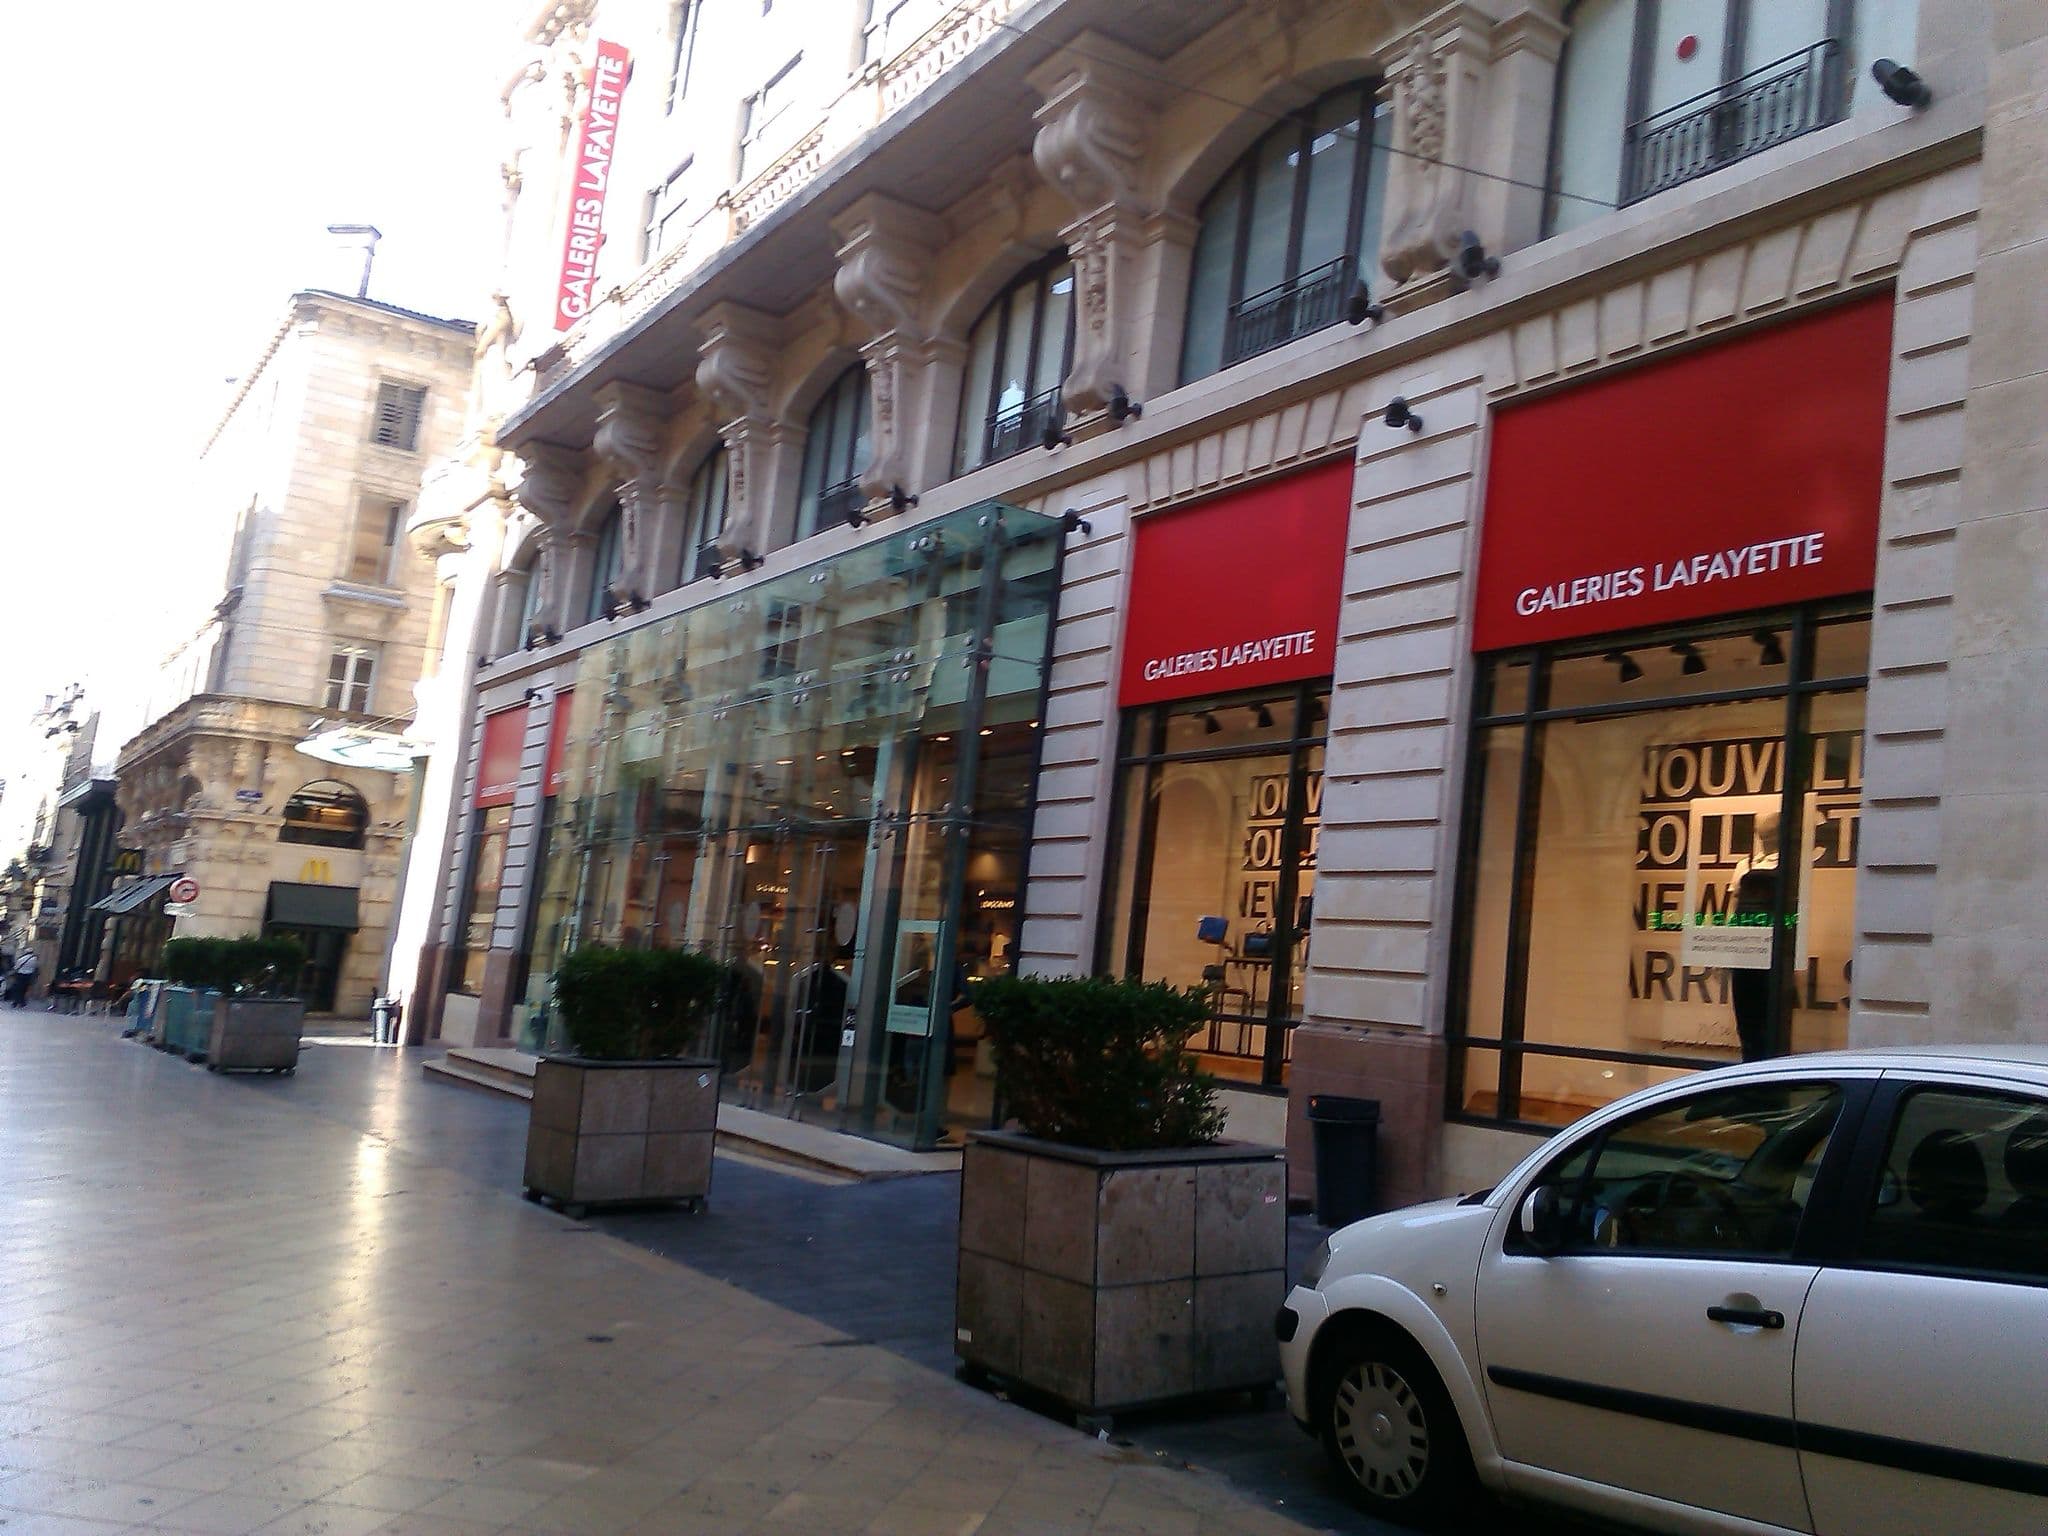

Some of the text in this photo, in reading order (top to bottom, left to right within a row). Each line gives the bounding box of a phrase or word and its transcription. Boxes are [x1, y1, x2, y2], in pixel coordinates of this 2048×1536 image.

[560, 54, 624, 319] GALERIES LAFAYETTE
[1515, 532, 1825, 616] GALERIES LAFAYETTE
[1143, 630, 1317, 681] GALERIES LAFAYETTE
